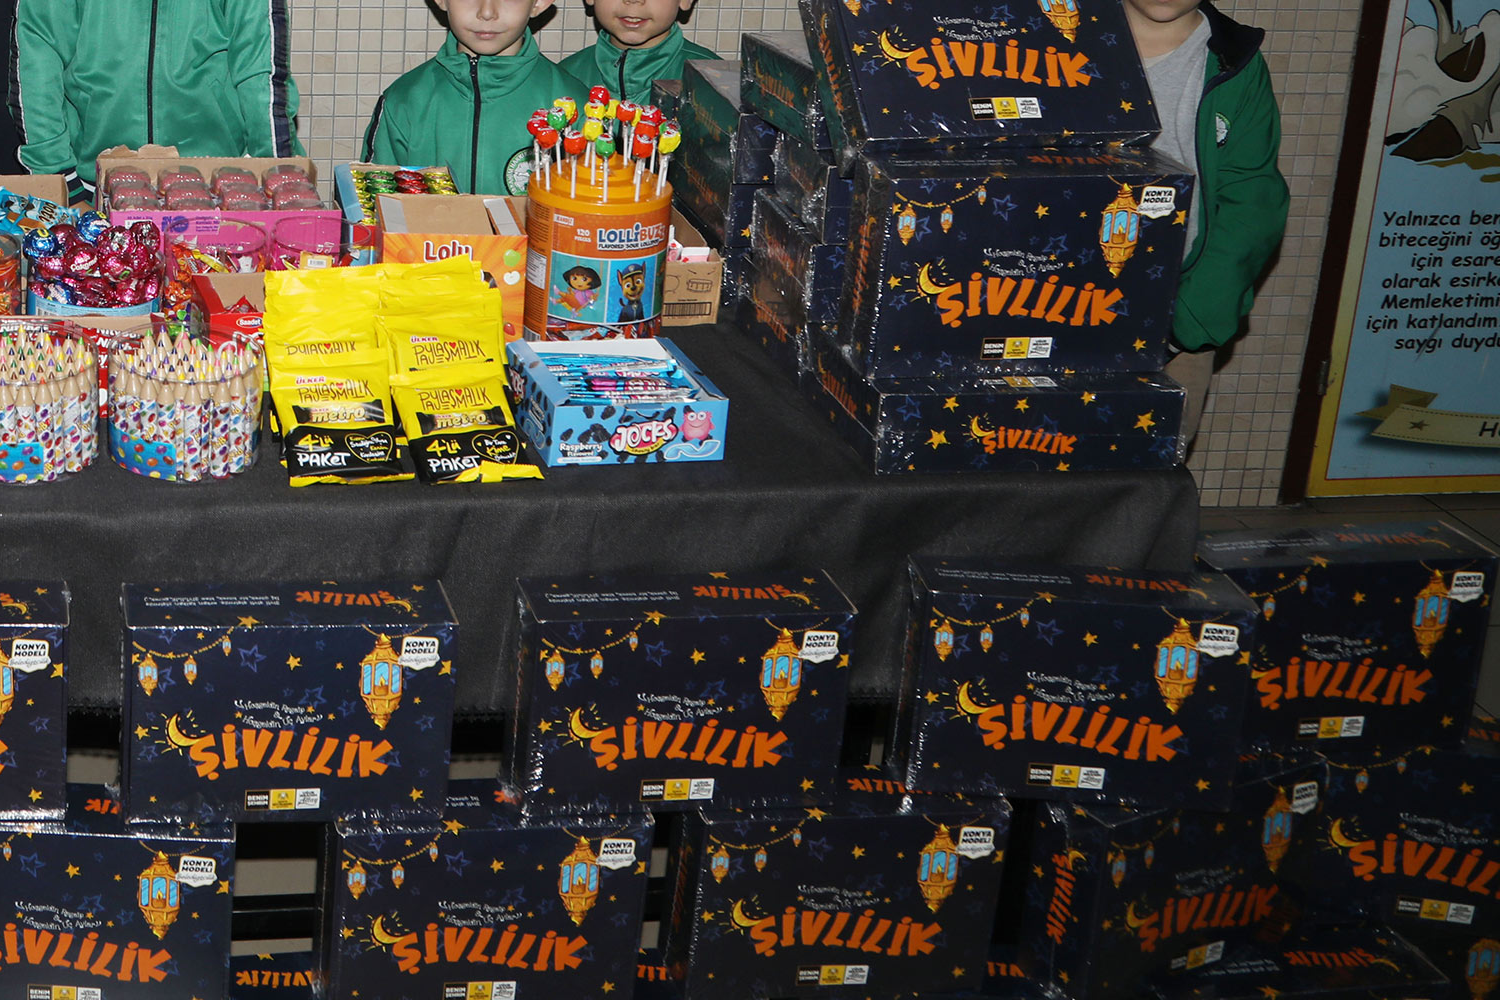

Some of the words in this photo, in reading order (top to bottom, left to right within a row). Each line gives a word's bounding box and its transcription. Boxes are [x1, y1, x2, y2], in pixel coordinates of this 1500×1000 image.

[906, 37, 1094, 89] ŞİVLİLİK
[1383, 210, 1461, 227] Yalnızca
[576, 228, 591, 236] 120
[1379, 230, 1473, 251] biteceğini
[1411, 253, 1443, 271] için
[1382, 273, 1442, 289] olarak
[936, 272, 1124, 328] ŞİVLİLİK
[239, 316, 261, 326] Saadet
[1366, 315, 1398, 333] için
[410, 335, 438, 343] ÜLKER
[1394, 338, 1443, 353] saygı
[296, 376, 325, 384] ÜLKER
[312, 405, 366, 423] metro
[436, 413, 487, 430] metro
[616, 419, 672, 451] JOCKS
[982, 426, 1078, 455] ŞİVLİLİK
[559, 443, 603, 453] Raspberry
[1257, 657, 1433, 710] ŞİVLİLİK
[977, 695, 1184, 762] ŞİVLİLİK
[189, 723, 393, 780] ŞİVLİLİK
[590, 716, 789, 771] ŞİVLİLİK
[750, 906, 941, 957] ŞİVLİLİK
[393, 922, 588, 974] ŞİVLİLİK
